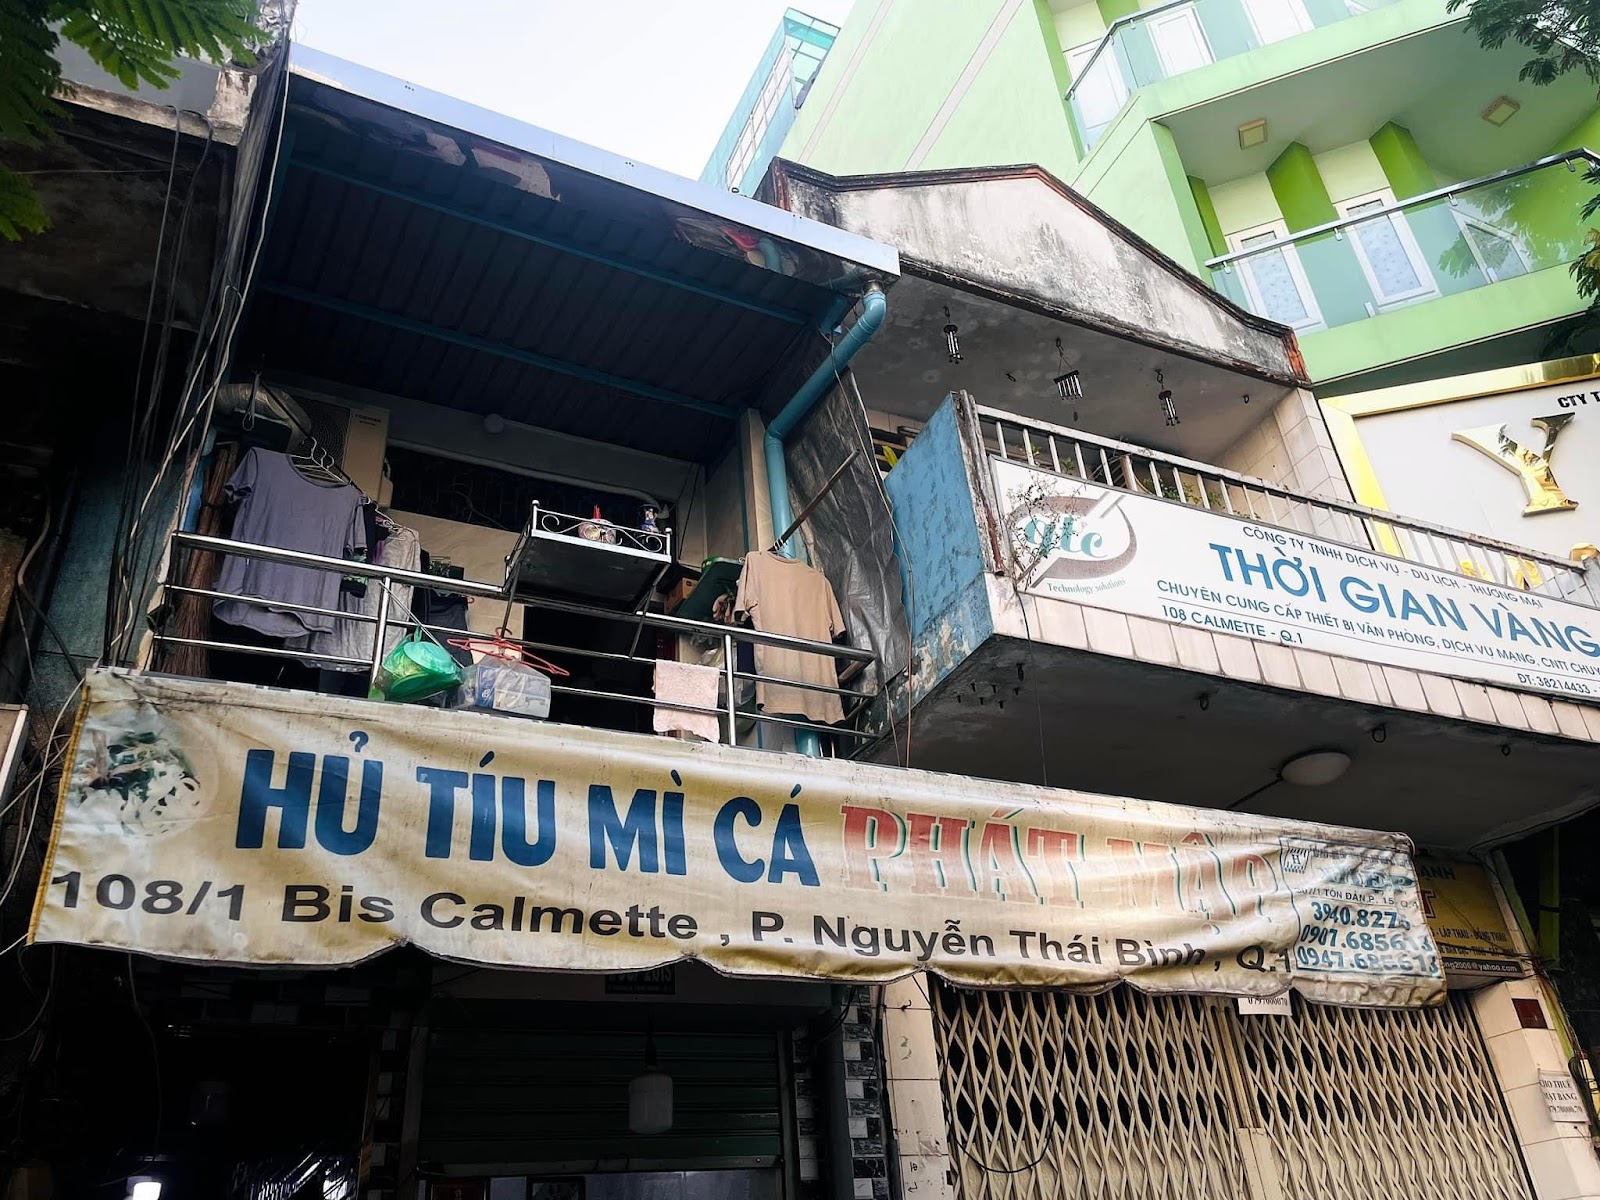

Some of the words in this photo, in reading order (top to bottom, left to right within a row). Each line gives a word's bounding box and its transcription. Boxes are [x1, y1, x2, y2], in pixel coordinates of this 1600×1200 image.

[1557, 393, 1588, 408] CTY
[1451, 412, 1579, 517] Y
[1047, 582, 1095, 595] Technology
[1096, 578, 1127, 593] solutions
[1242, 526, 1287, 546] CÔNG
[1288, 537, 1304, 550] TY
[1308, 542, 1343, 561] TNHH
[1345, 552, 1379, 569] DỊCH
[1380, 561, 1400, 576] VỤ
[1411, 569, 1430, 581] DU
[1431, 574, 1460, 589] LỊCH
[1156, 579, 1222, 604] CHUYÊN
[1225, 594, 1270, 613] CUNG
[1273, 602, 1302, 619] CẤP
[1304, 611, 1340, 629] THIẾT
[1343, 620, 1356, 635] BỊ
[1356, 621, 1385, 638] VĂN
[1387, 628, 1440, 649] PHÒNG,
[1442, 638, 1474, 654] DỊCH
[1474, 645, 1494, 660] VỤ
[1496, 648, 1541, 667] MẠNG,
[1541, 657, 1569, 672] CNTT
[1162, 604, 1187, 621] 108
[1191, 611, 1267, 637] CALMETTE
[1280, 629, 1303, 645] Q.1
[1208, 542, 1327, 603] THỜI
[1339, 575, 1468, 632] GIAN
[1469, 602, 1600, 658] VÀNG
[234, 730, 383, 856] HỦ
[415, 750, 557, 868] TÍU
[587, 768, 688, 876] MÌ
[713, 783, 822, 887] CÁ
[839, 797, 1085, 908] PHÁT
[1105, 831, 1279, 937] MẬP
[51, 871, 246, 922] 108/1
[281, 884, 395, 924] Bis
[420, 891, 699, 941] Calmette
[751, 910, 793, 944] P.
[813, 914, 997, 962] Nguyễn
[1009, 929, 1103, 965] Thái
[1115, 937, 1207, 968] Bình
[1236, 943, 1292, 974] Q.1
[1383, 897, 1395, 905] 15
